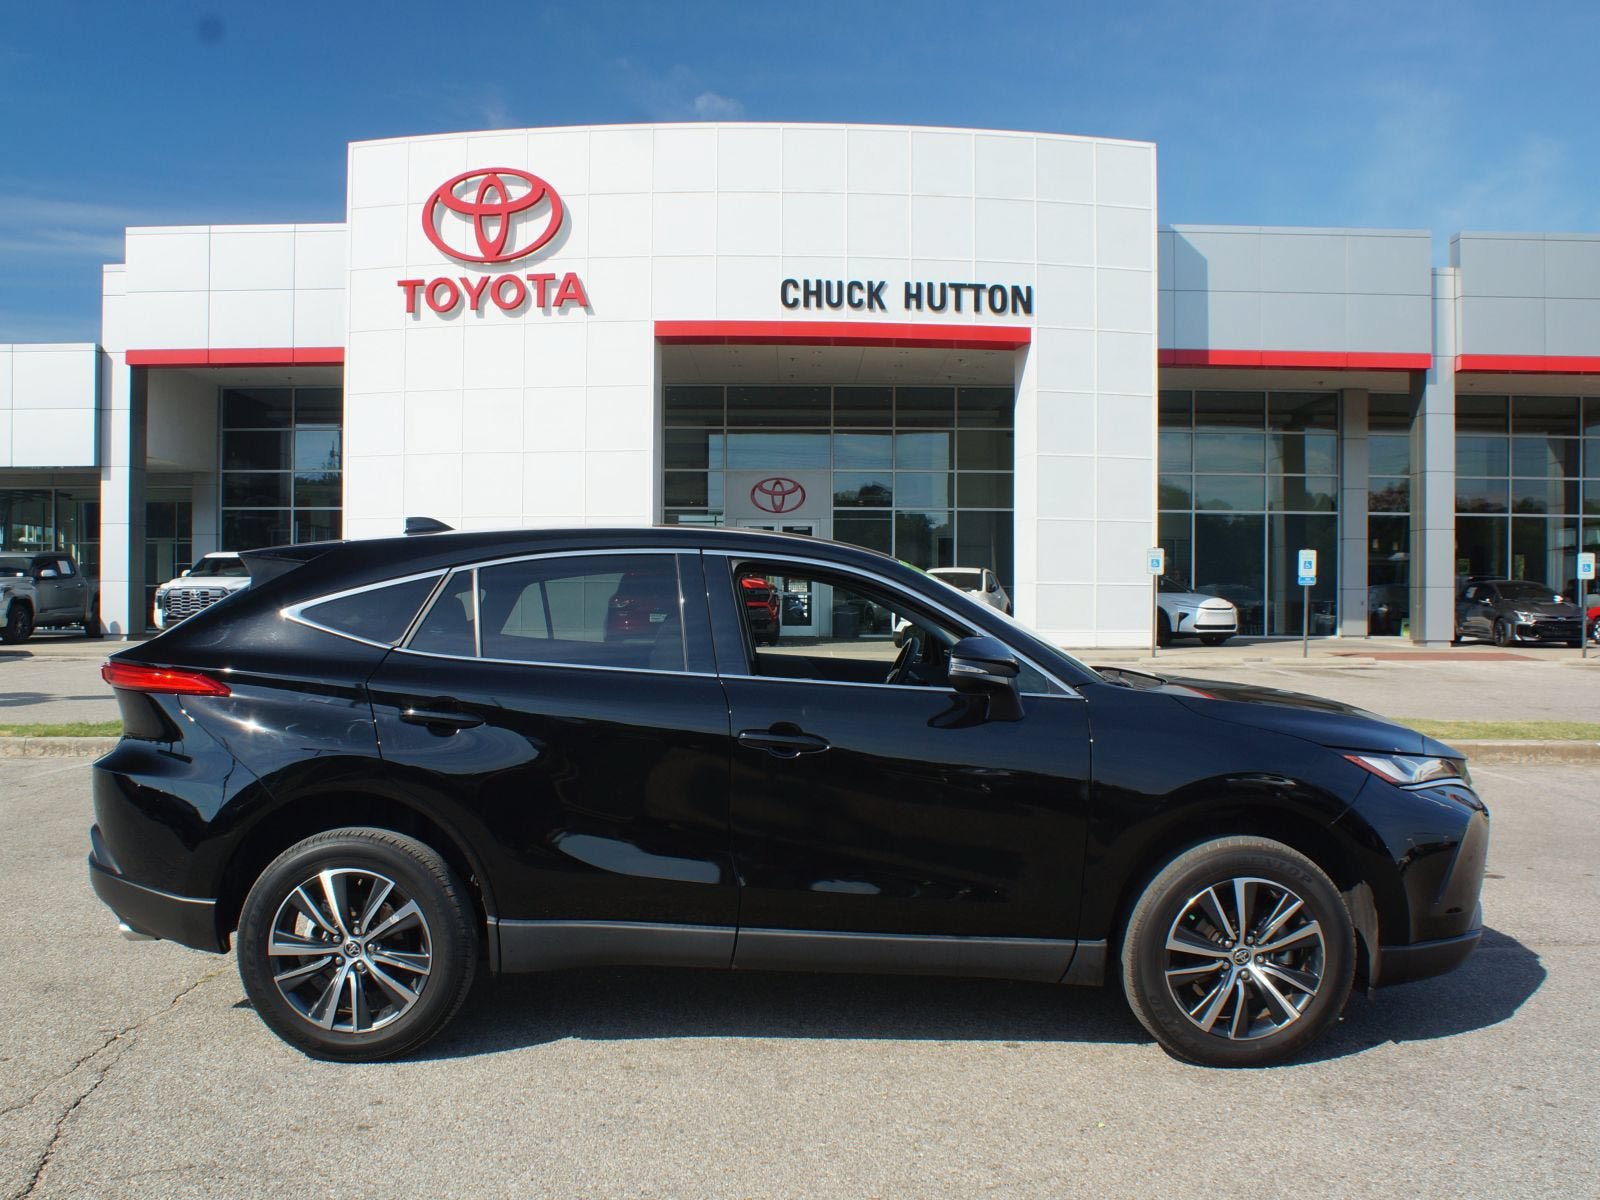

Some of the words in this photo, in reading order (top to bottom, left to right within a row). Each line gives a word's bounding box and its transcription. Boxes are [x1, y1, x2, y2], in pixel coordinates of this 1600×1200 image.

[397, 272, 588, 313] TOYOTA
[780, 278, 886, 310] CHUCK
[904, 281, 1032, 314] HUTTON
